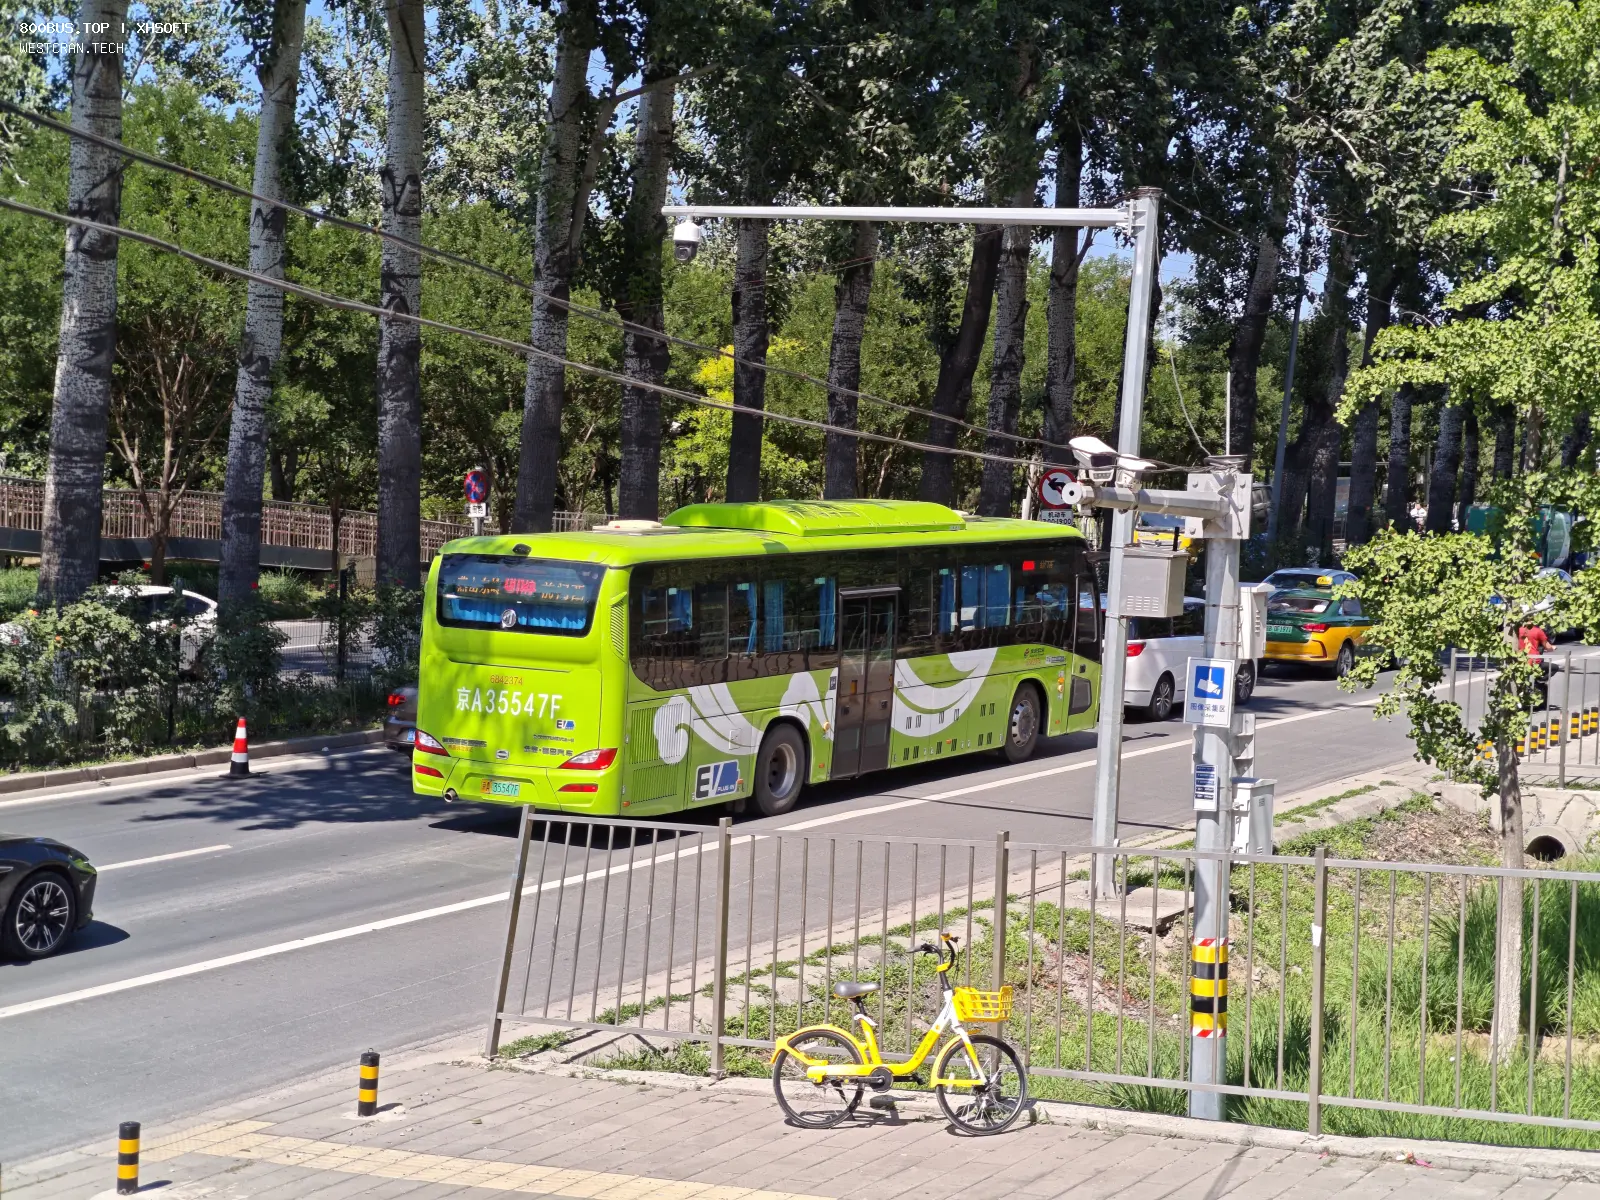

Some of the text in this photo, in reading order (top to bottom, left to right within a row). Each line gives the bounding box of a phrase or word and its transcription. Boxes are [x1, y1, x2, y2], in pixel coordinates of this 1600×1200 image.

[490, 674, 523, 686] 6842374
[456, 686, 563, 720] 京A35547F
[1190, 702, 1226, 713] 图像采集区
